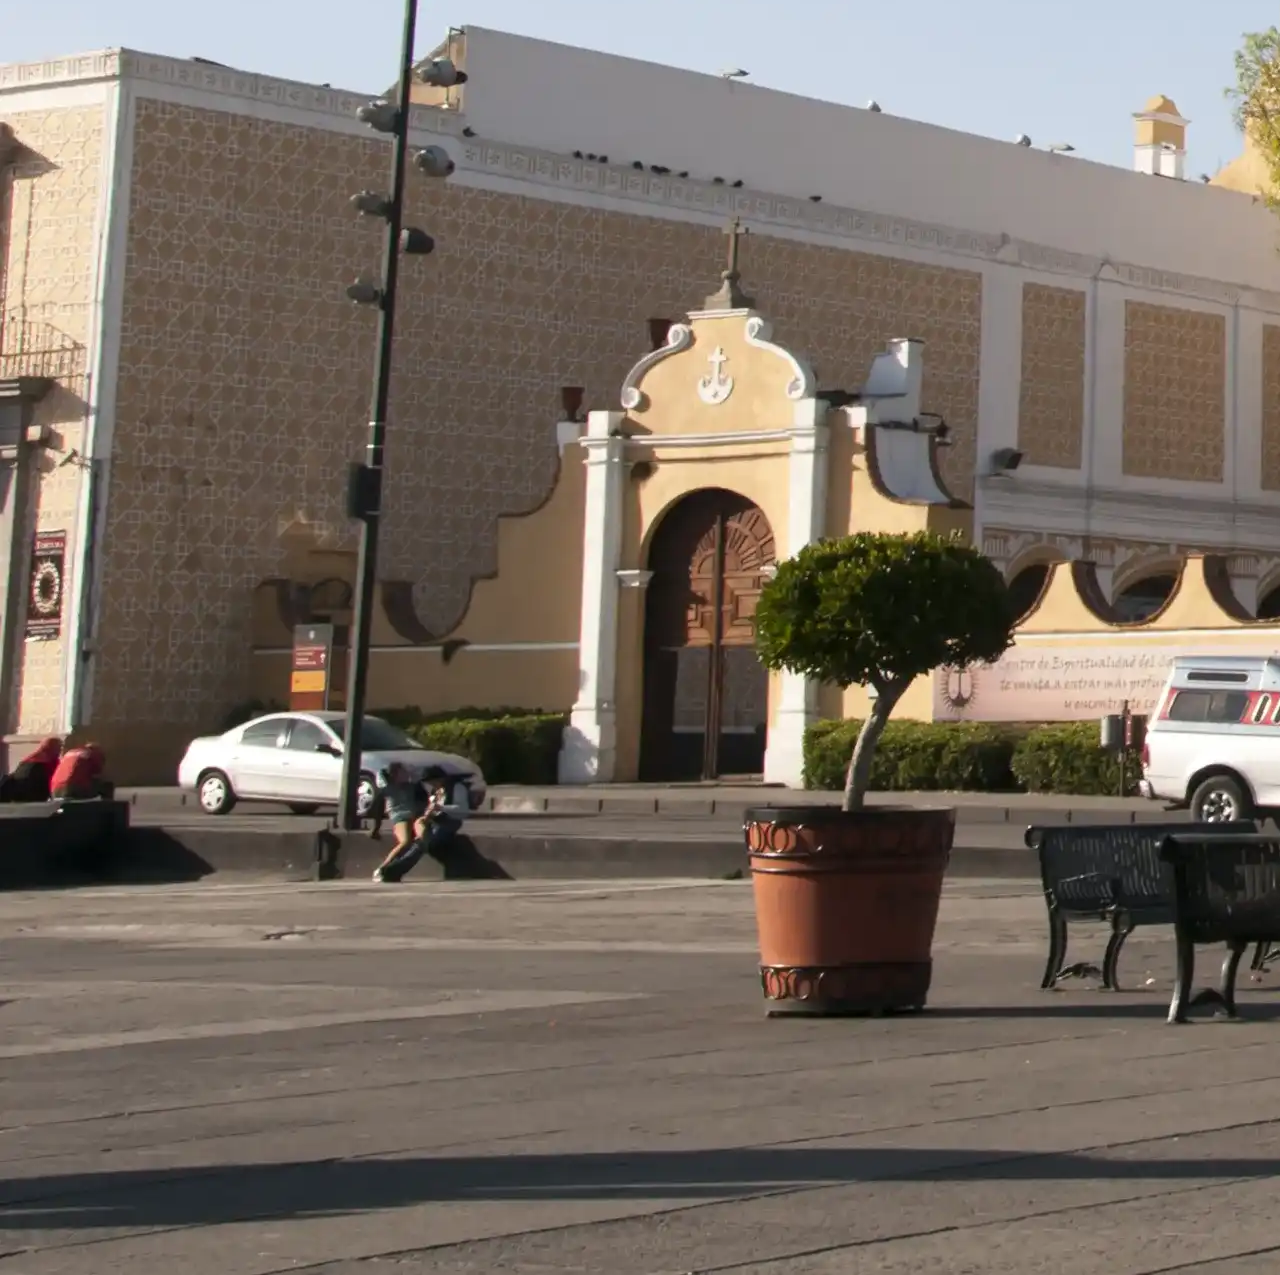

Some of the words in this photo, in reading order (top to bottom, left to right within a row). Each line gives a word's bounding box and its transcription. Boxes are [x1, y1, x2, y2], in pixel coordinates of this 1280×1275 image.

[1037, 654, 1050, 669] de
[1051, 655, 1136, 675] Espiritualidad
[1139, 653, 1156, 668] del
[1000, 677, 1011, 691] te
[1064, 677, 1100, 689] entrar
